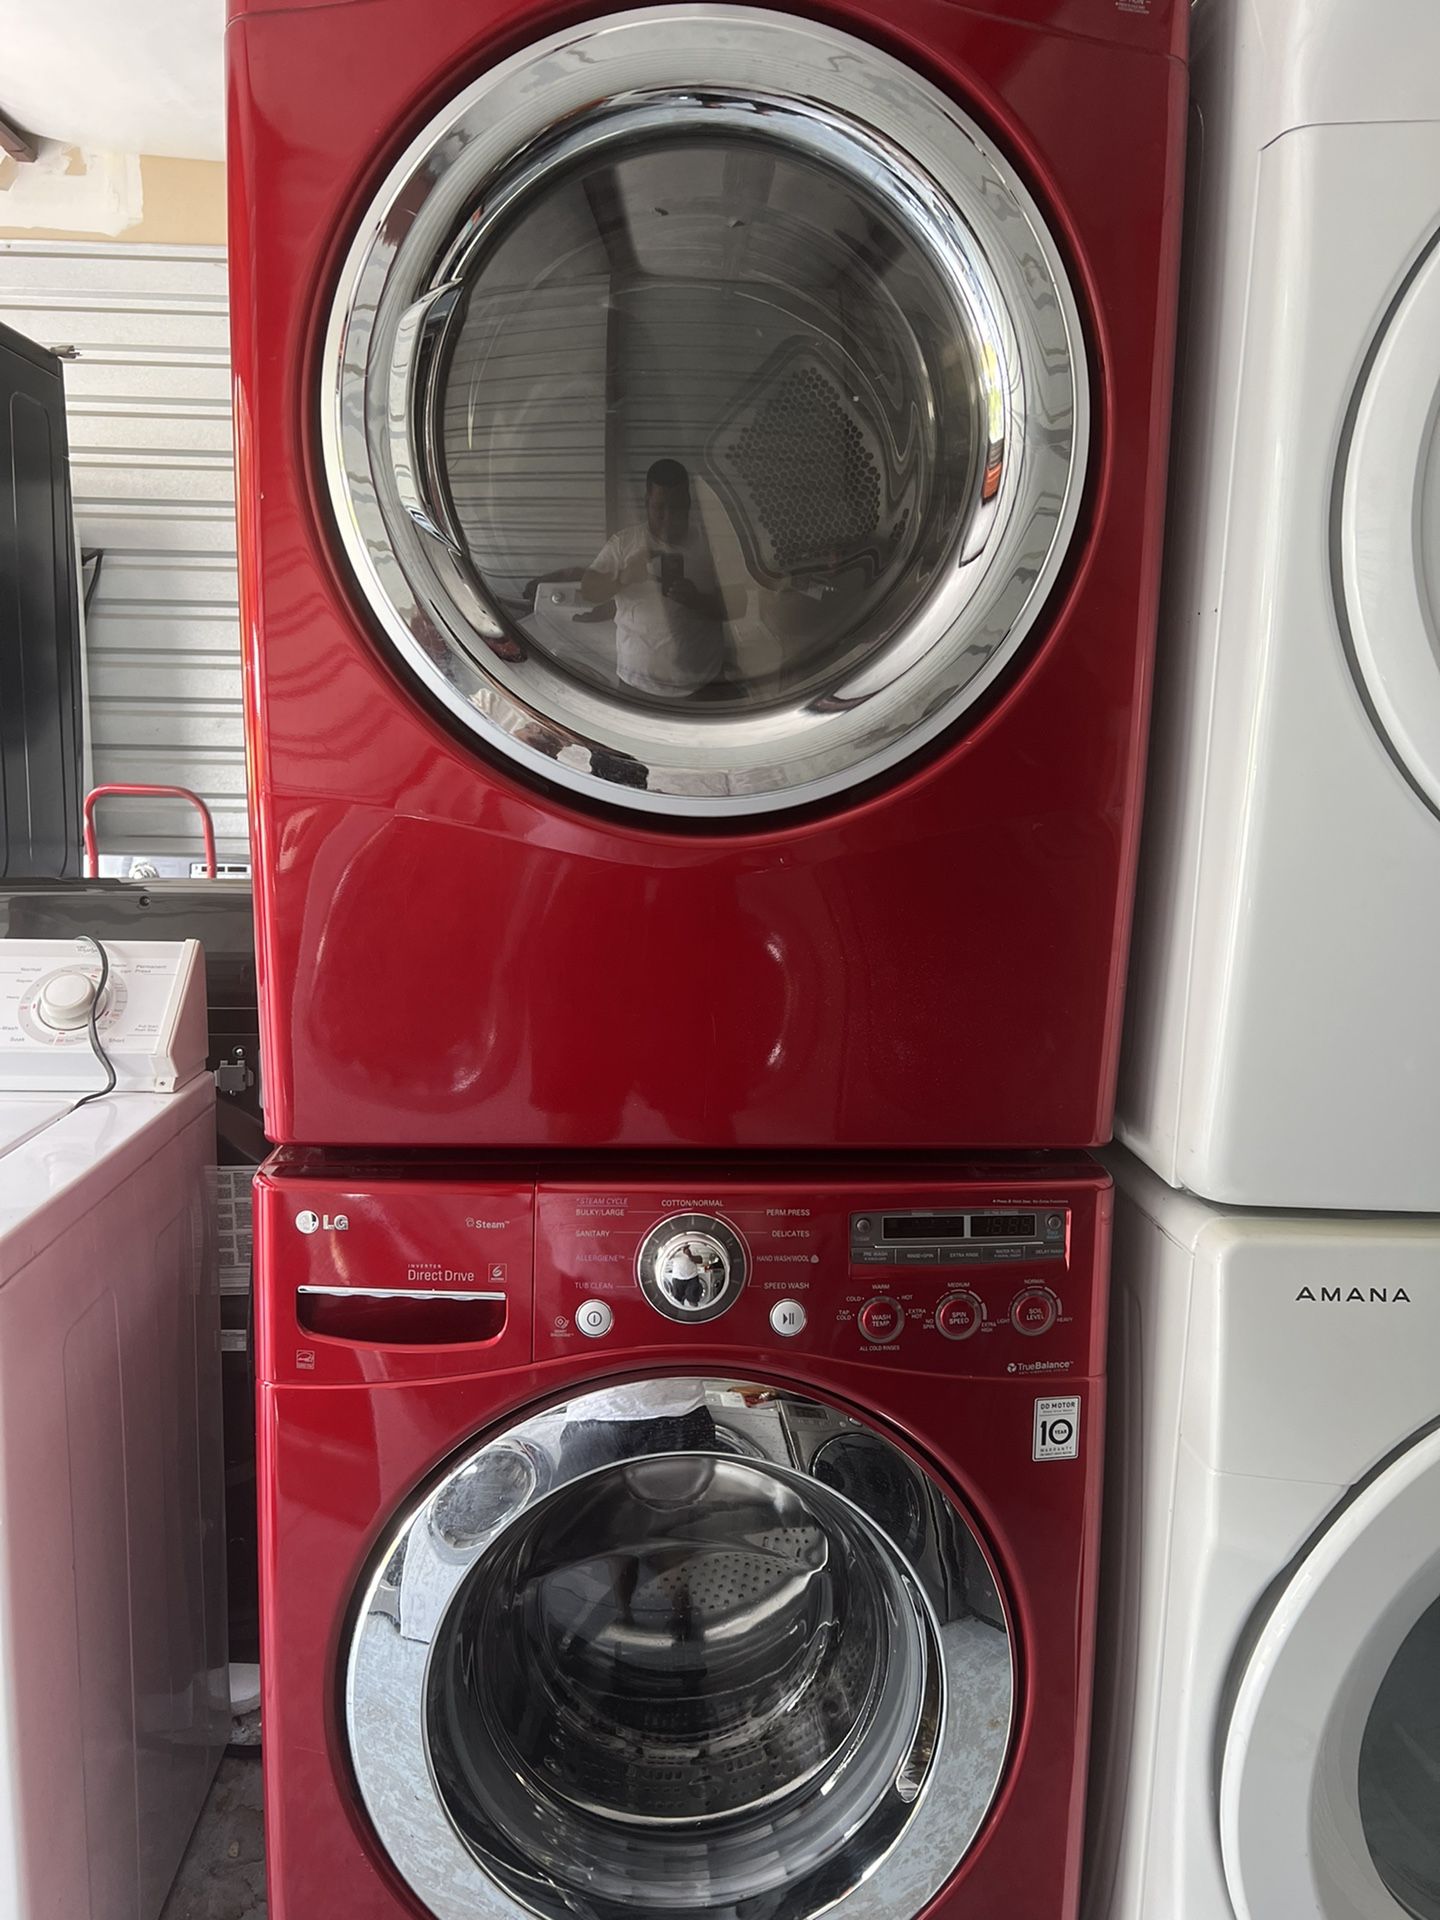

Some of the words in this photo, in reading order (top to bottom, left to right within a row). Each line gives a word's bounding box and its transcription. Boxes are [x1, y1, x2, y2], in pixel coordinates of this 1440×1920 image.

[606, 1198, 629, 1206] CYCLE
[661, 1199, 724, 1207] COTTON/NORMAL
[575, 1209, 625, 1217] BULKY/LARGE
[322, 1214, 349, 1230] LG
[575, 1230, 610, 1238] SANITARY
[771, 1230, 810, 1238] DELICATES
[407, 1269, 442, 1281] Direct
[444, 1270, 475, 1282] Drive
[1295, 1286, 1411, 1303] AMANA
[949, 1317, 970, 1325] SPEED
[1026, 1313, 1045, 1321] LEVEL
[1051, 1401, 1076, 1409] MOTOR
[1040, 1418, 1073, 1446] 10
